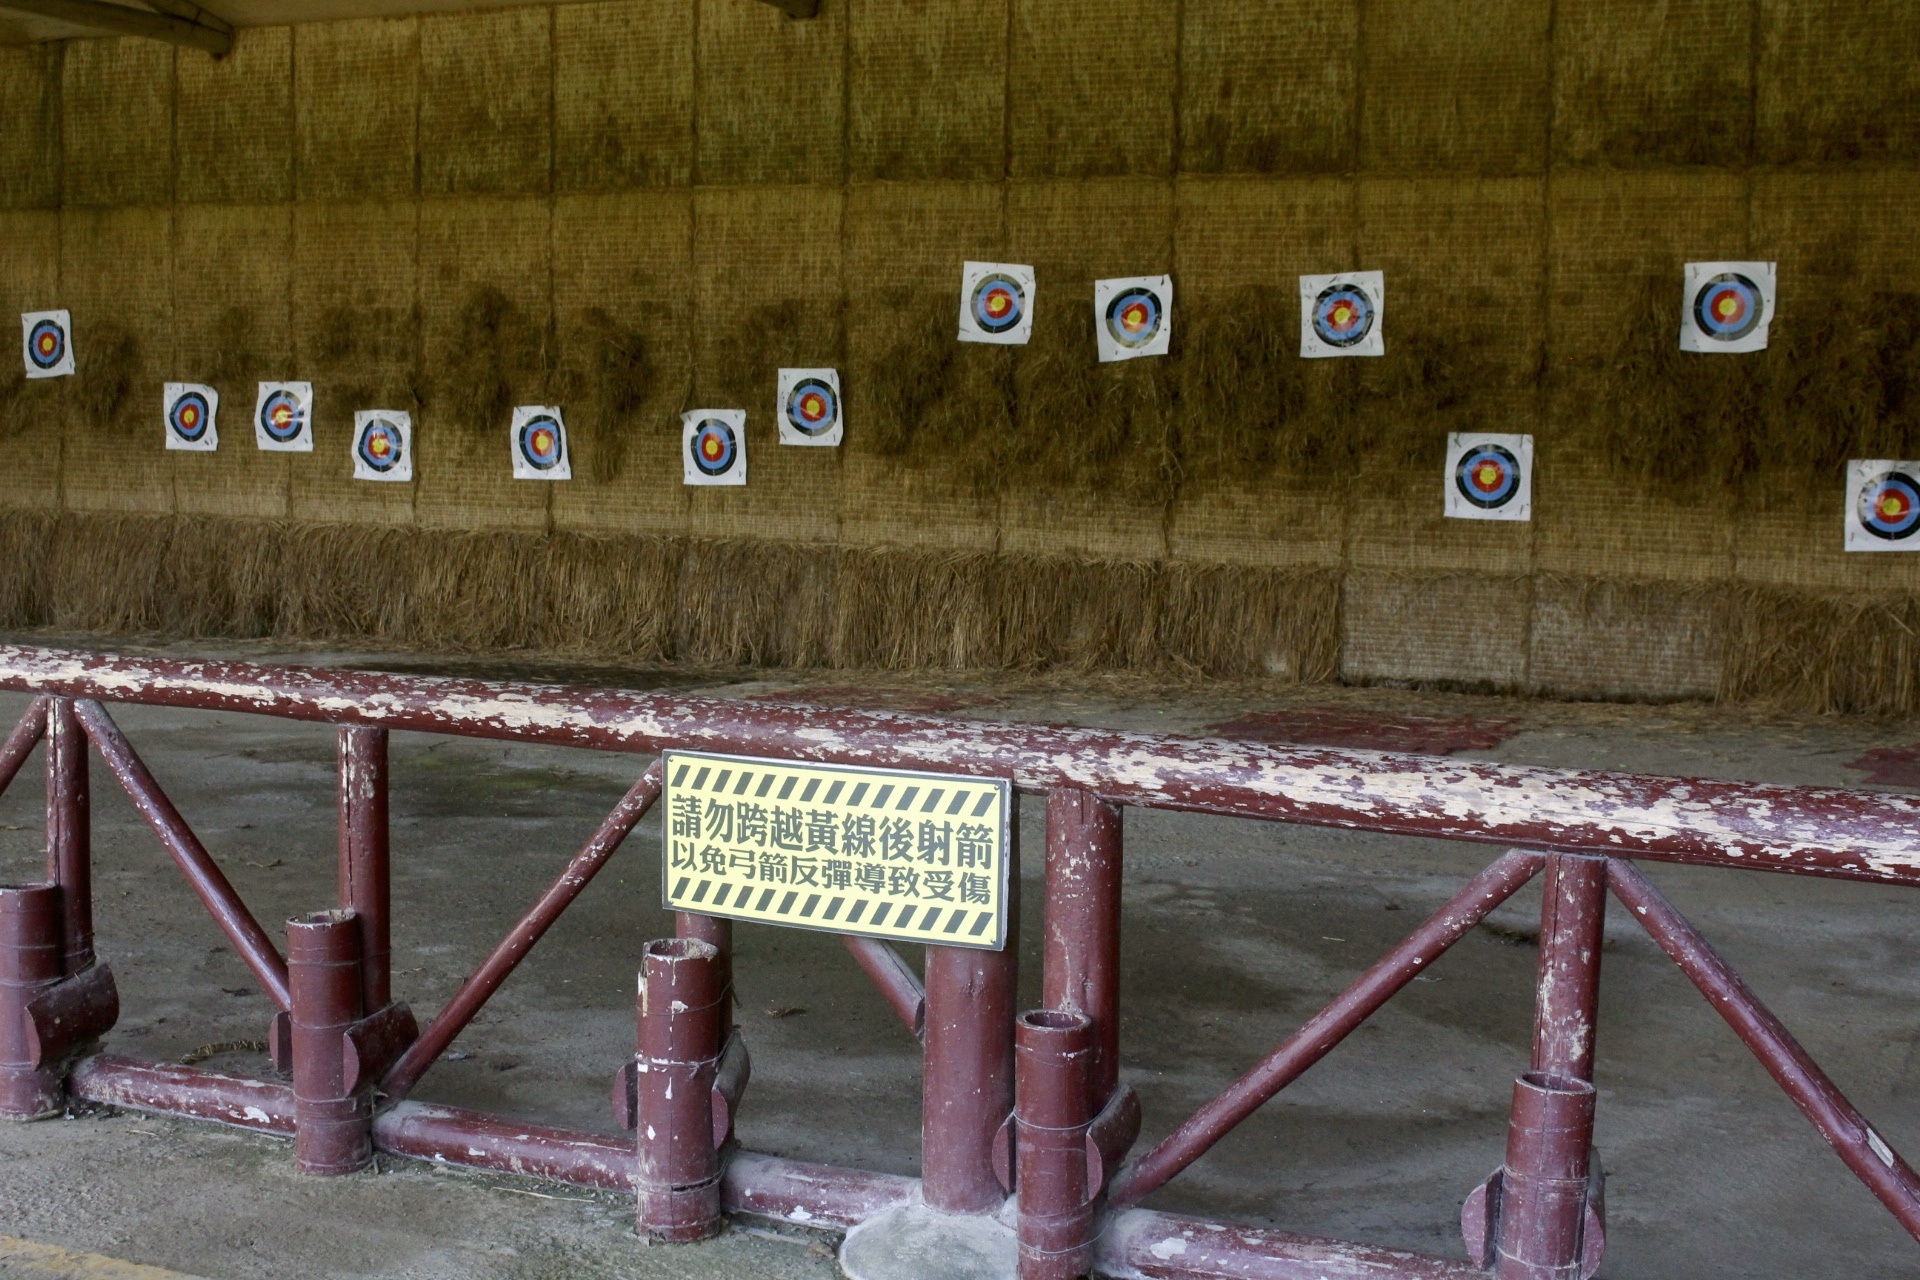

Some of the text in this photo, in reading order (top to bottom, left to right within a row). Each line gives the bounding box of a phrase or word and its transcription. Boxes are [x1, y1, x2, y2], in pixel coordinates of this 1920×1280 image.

[672, 794, 994, 870] 請勿跨越黃線後射箭
[671, 840, 992, 905] 以免弓箭反彈導致受傷
